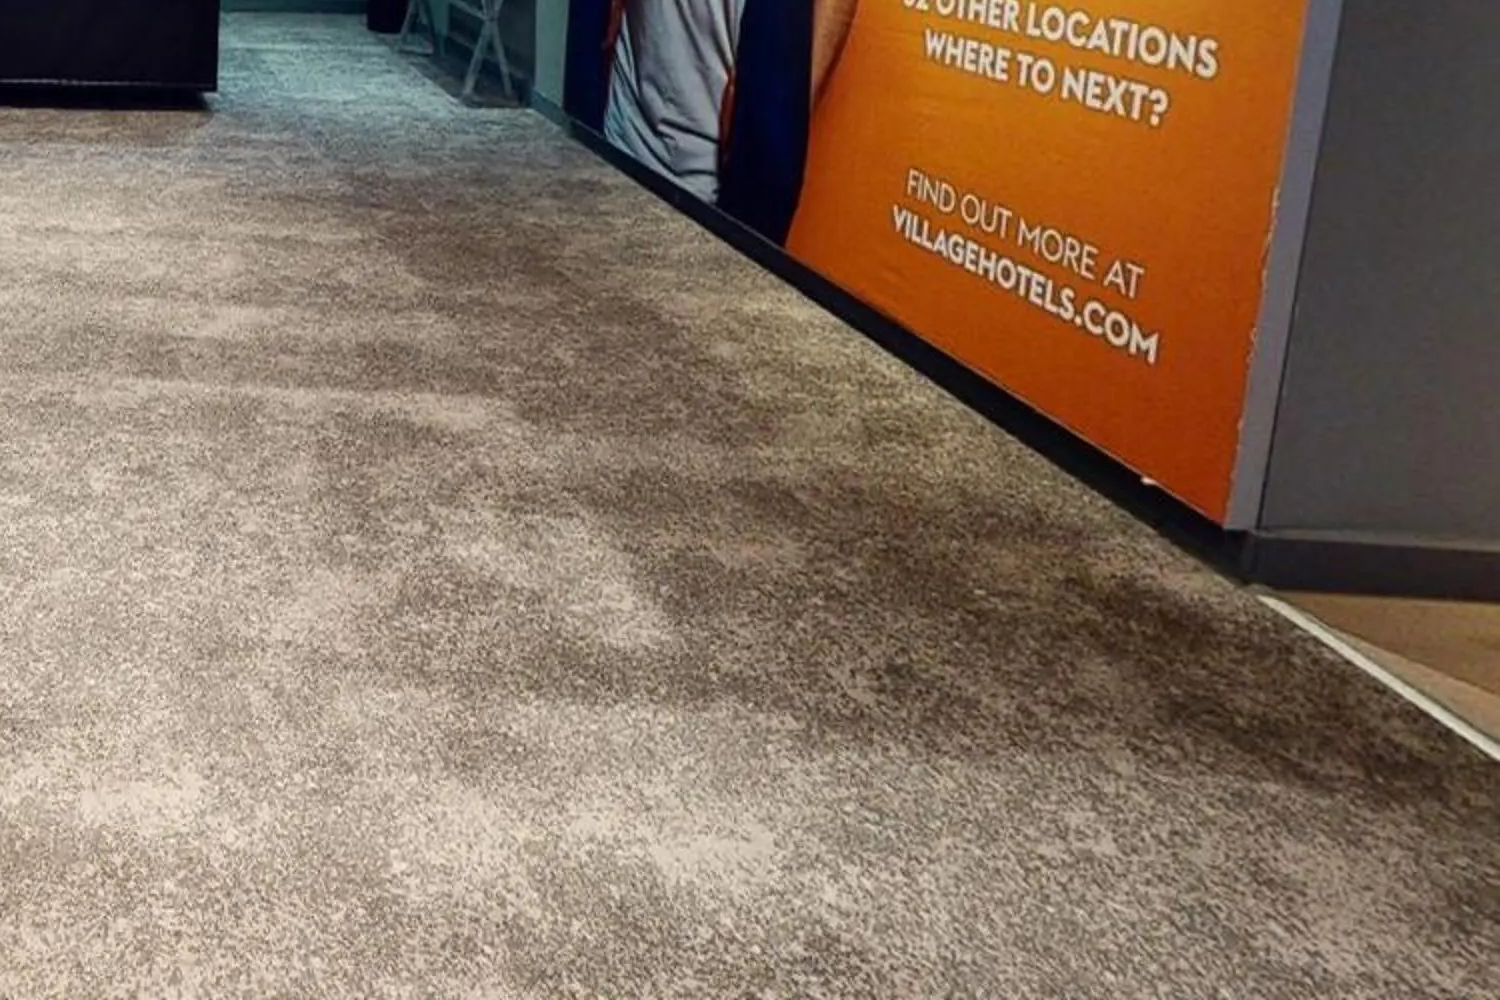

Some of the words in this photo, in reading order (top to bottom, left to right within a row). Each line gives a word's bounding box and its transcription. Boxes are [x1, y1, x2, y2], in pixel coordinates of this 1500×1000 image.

[925, 28, 1010, 82] WHERE
[1016, 53, 1055, 92] TO
[1060, 68, 1169, 126] NEXT?
[1026, 7, 1220, 78] LOCATIONS
[893, 206, 1159, 364] VILLAGEHOTELS.COM
[907, 168, 956, 214] FIND
[960, 194, 1012, 238] OUT
[1018, 219, 1098, 280] MORE
[1104, 260, 1144, 299] AT
